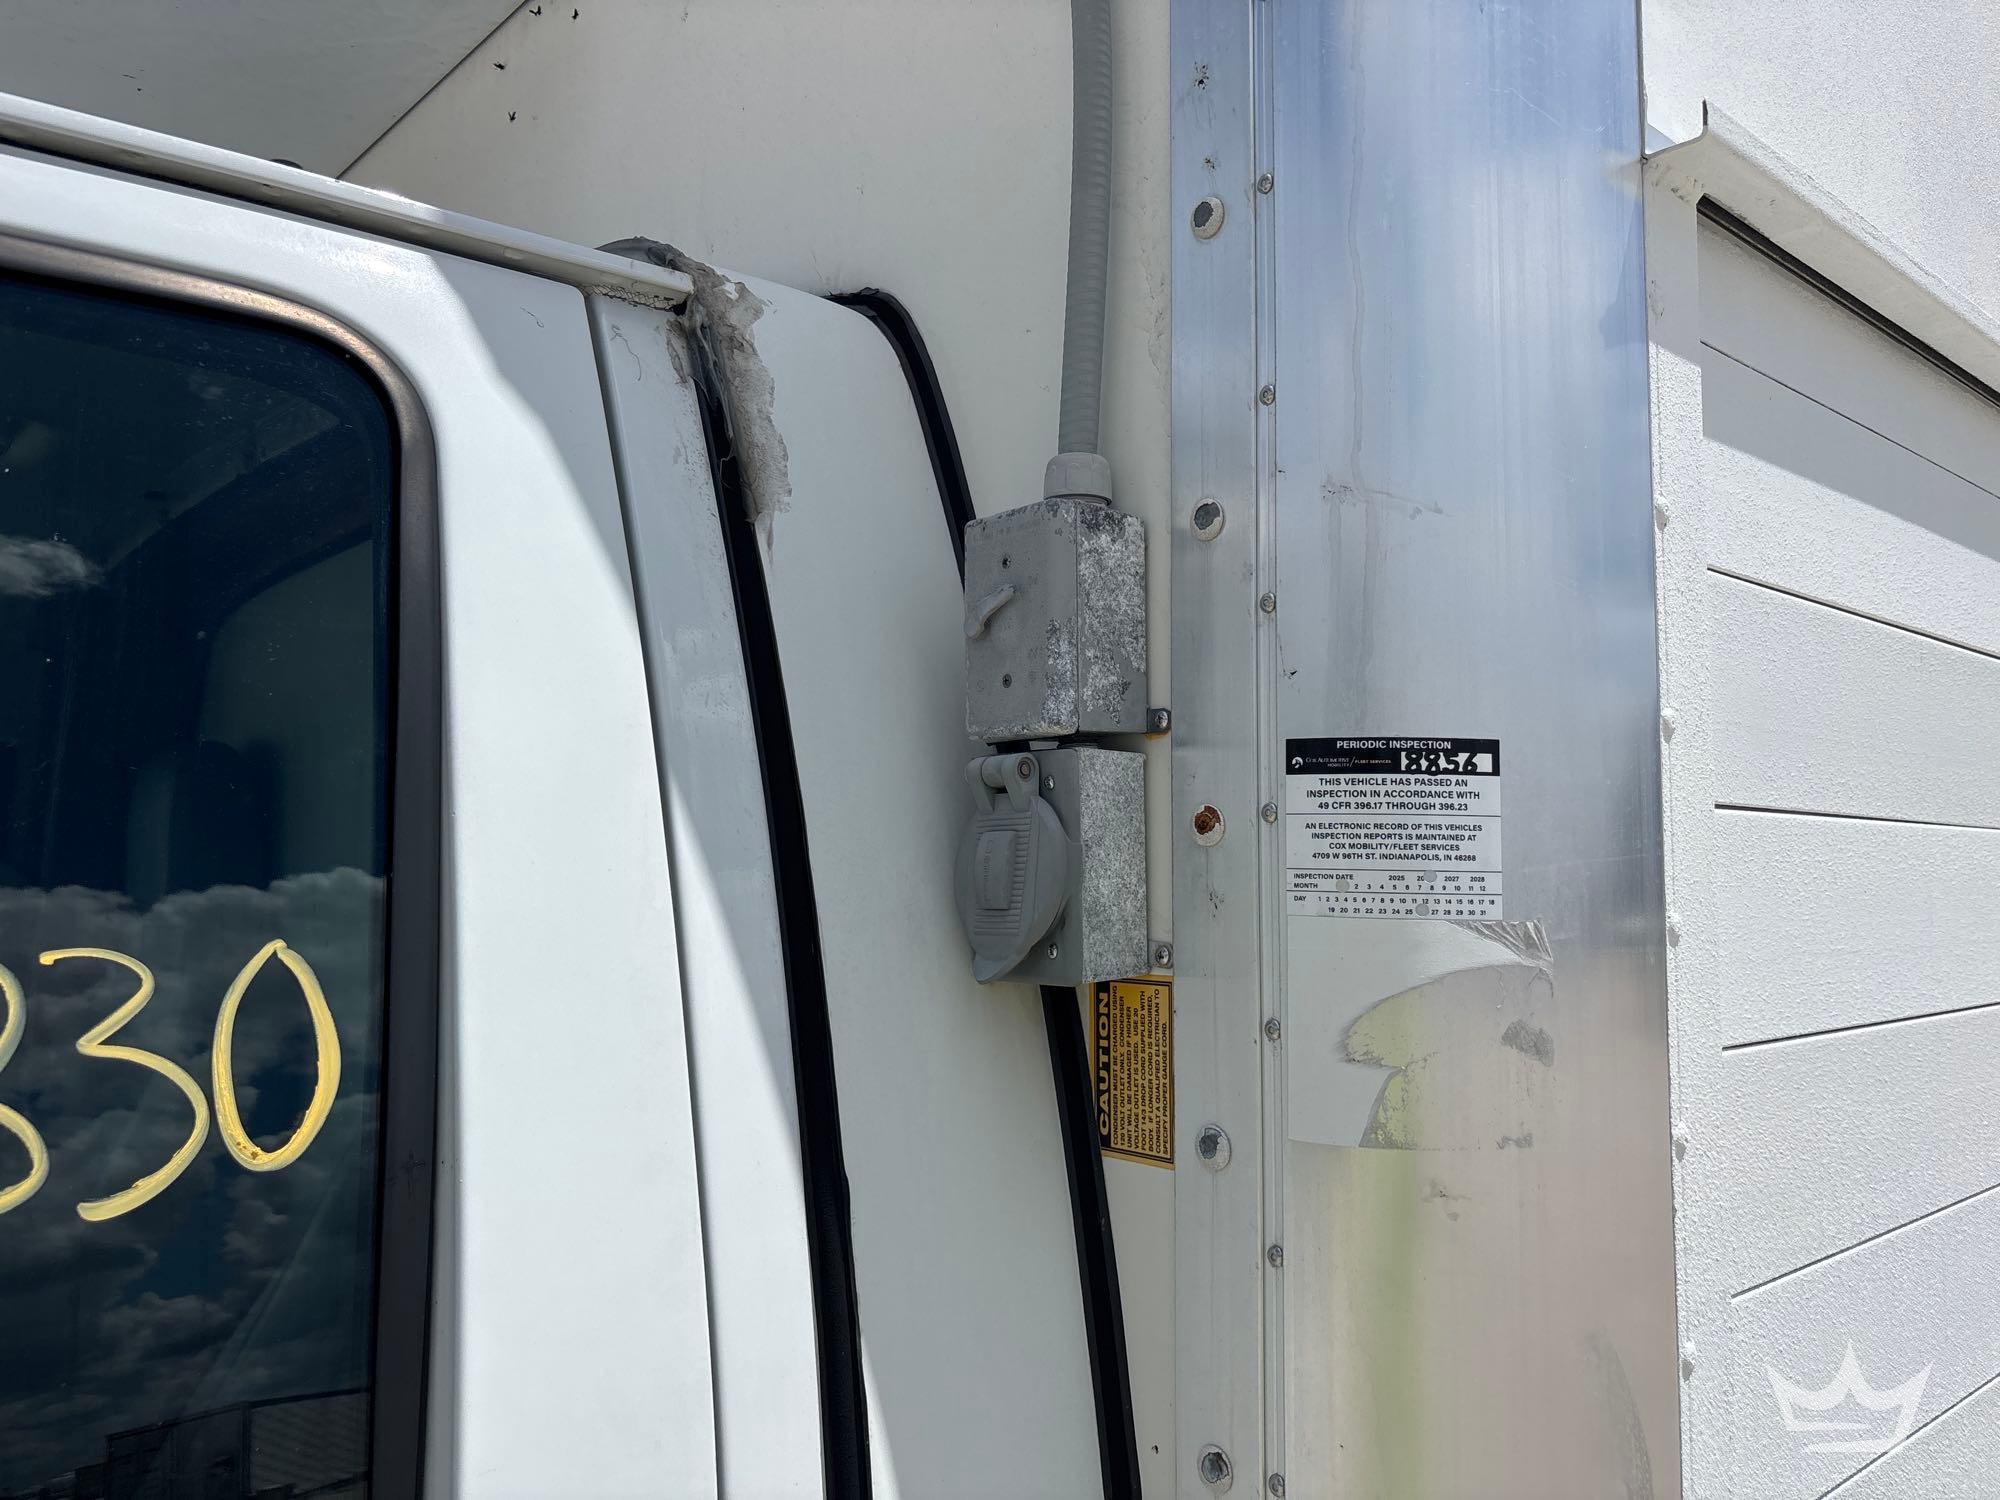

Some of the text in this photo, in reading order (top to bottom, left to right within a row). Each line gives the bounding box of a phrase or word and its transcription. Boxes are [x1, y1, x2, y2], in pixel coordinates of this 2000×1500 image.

[1336, 740, 1452, 749] PERIODIC INSPECTION
[1405, 751, 1478, 776] 8856
[1307, 790, 1366, 798] INSPECTION
[1383, 790, 1453, 799] ACCORDANCE
[1456, 791, 1480, 799] WITH
[1385, 802, 1436, 810] THROUGH
[1379, 853, 1442, 861] INDIANAPOLIS,
[1154, 989, 1159, 1000] TO
[1134, 1008, 1138, 1017] 20
[1099, 993, 1109, 1136] CAUTION
[1113, 1055, 1117, 1066] BE
[1127, 1094, 1131, 1104] BE
